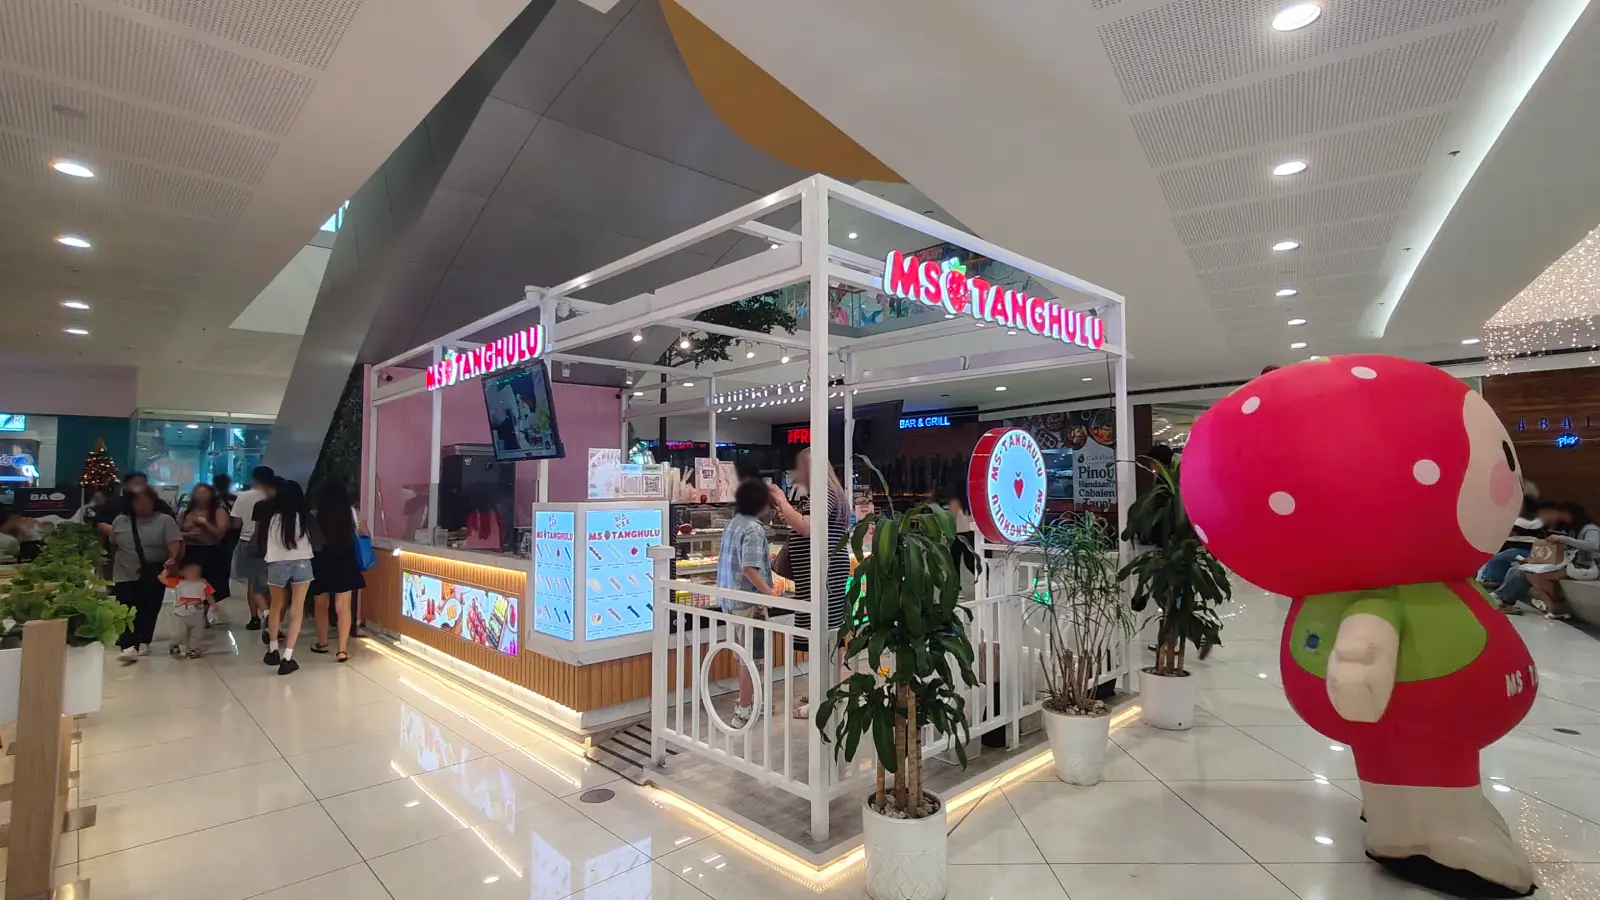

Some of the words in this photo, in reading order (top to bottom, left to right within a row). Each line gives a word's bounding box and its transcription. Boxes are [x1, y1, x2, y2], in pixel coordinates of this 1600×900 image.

[884, 250, 942, 305] MS
[967, 275, 1105, 351] TANGHULU
[426, 361, 446, 391] MS
[455, 324, 545, 381] TANGHULU
[899, 419, 917, 429] BAR
[917, 417, 924, 428] &
[925, 416, 951, 427] GRILL
[1078, 465, 1115, 482] Pinoy
[1078, 488, 1116, 498] Cabalen
[547, 531, 574, 541] TANGHULU
[587, 531, 603, 541] MS
[612, 528, 661, 540] TANGHULU
[1505, 669, 1524, 698] MS
